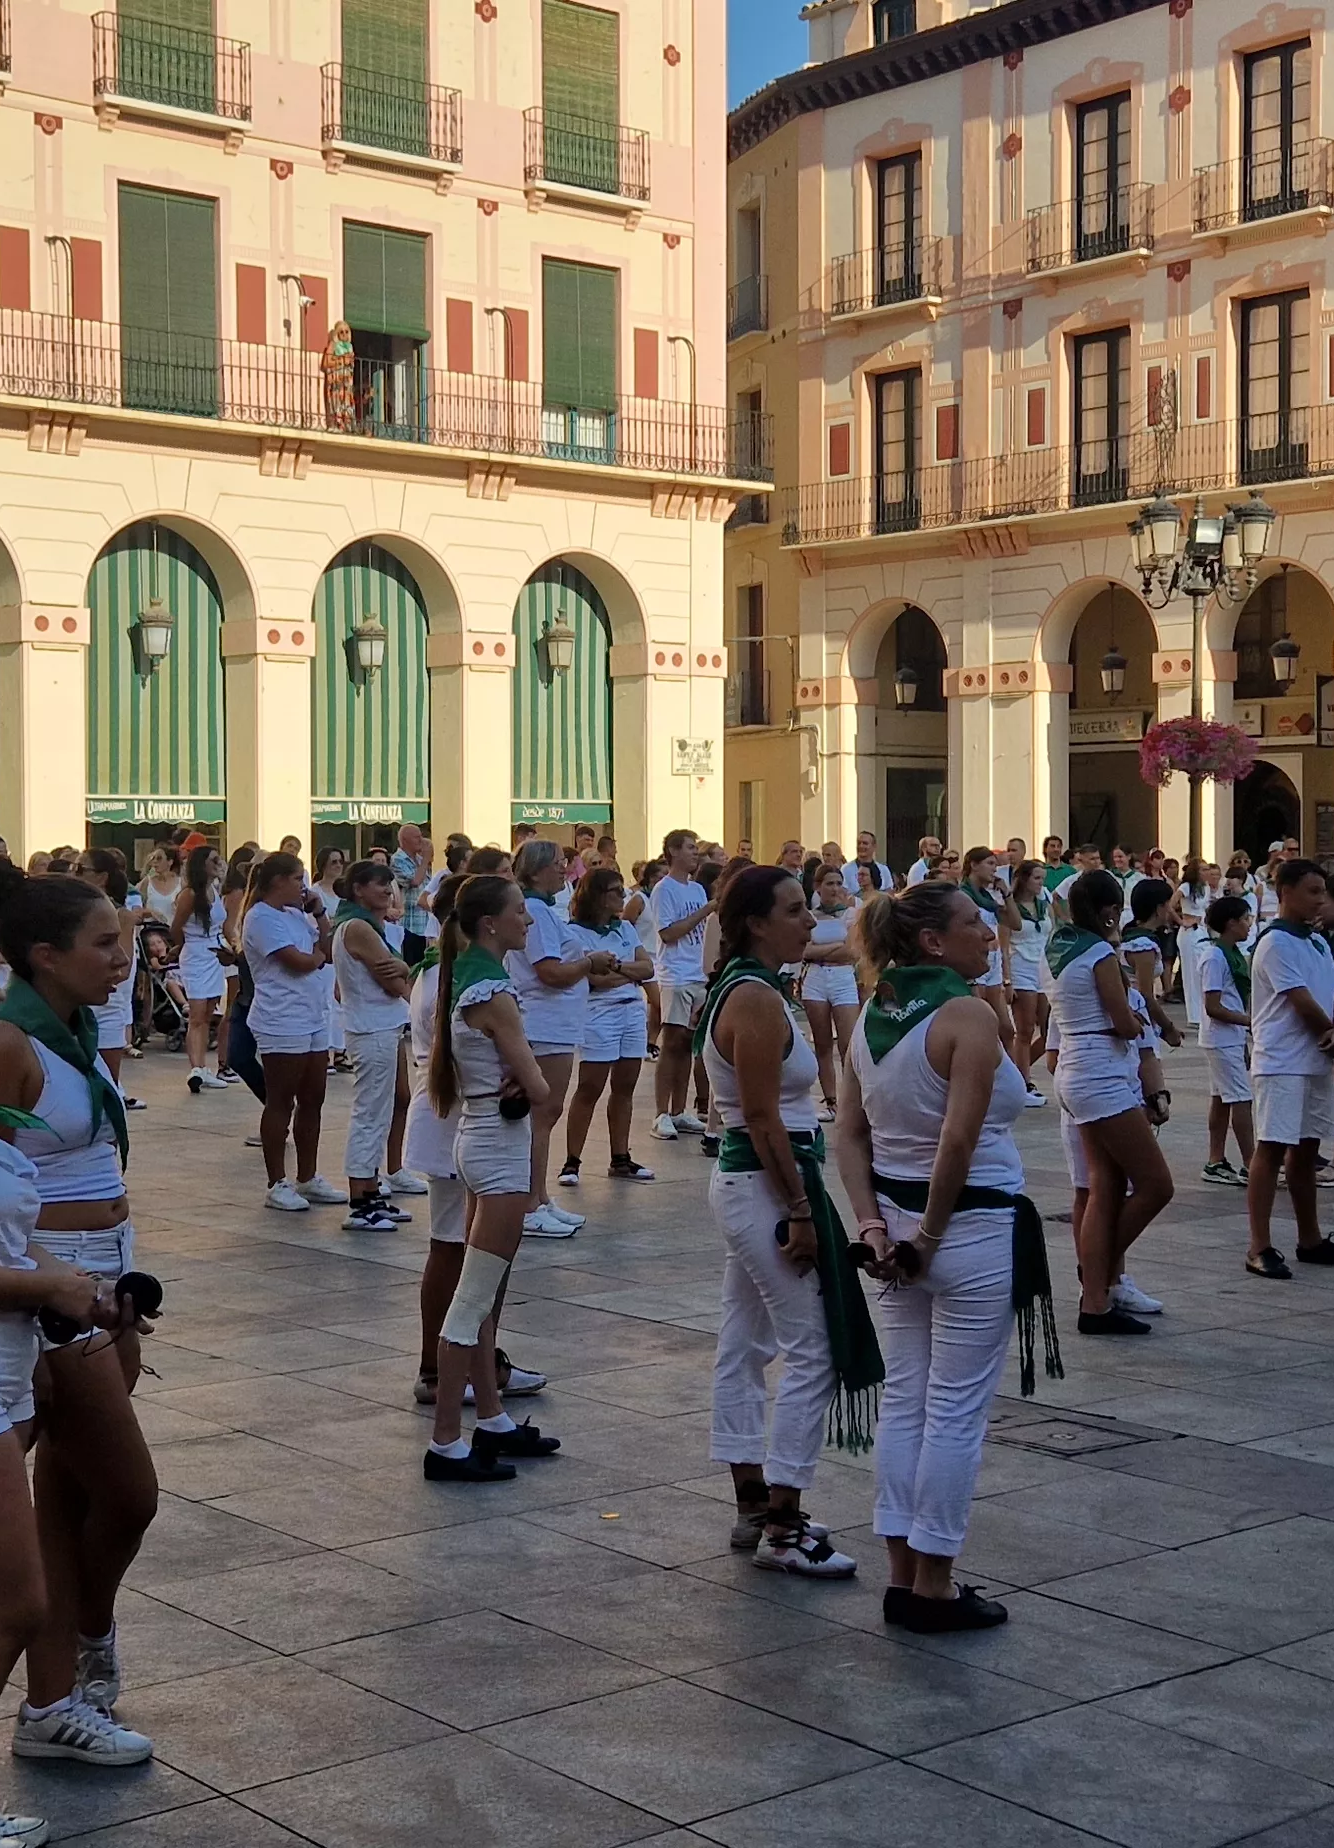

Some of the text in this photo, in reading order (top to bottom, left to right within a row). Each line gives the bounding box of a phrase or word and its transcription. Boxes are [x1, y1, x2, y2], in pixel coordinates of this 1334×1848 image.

[134, 800, 146, 820] LA
[148, 800, 195, 820] CONFIANZA
[348, 802, 359, 820] LA
[360, 802, 403, 820] CONFIANZA
[522, 805, 565, 820] desde 1871
